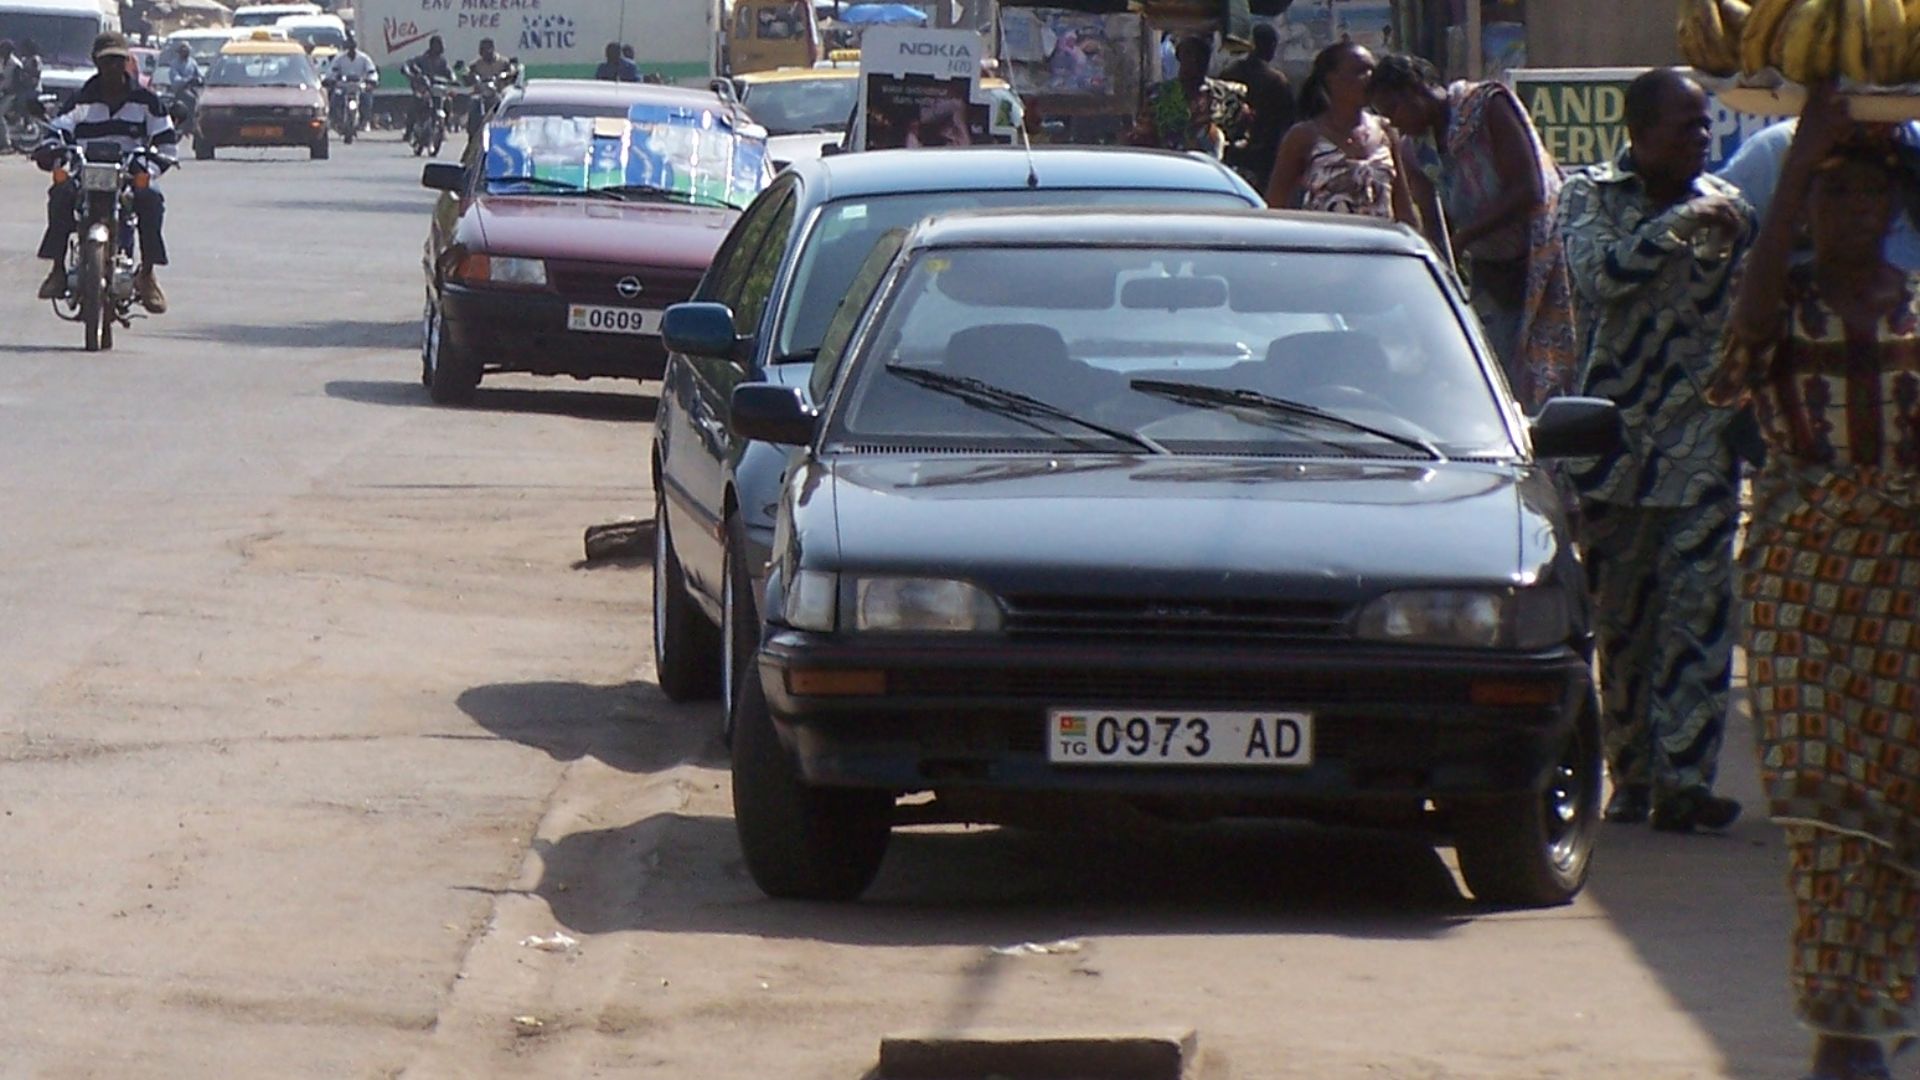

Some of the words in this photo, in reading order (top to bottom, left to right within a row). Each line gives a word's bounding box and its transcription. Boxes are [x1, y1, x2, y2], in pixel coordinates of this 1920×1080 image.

[900, 42, 971, 57] NOKIA
[1531, 86, 1625, 123] AND
[1538, 125, 1631, 162] ERV
[589, 309, 643, 330] 0609
[1060, 741, 1087, 756] TG
[1095, 716, 1211, 757] 0973
[1246, 718, 1301, 758] AD
